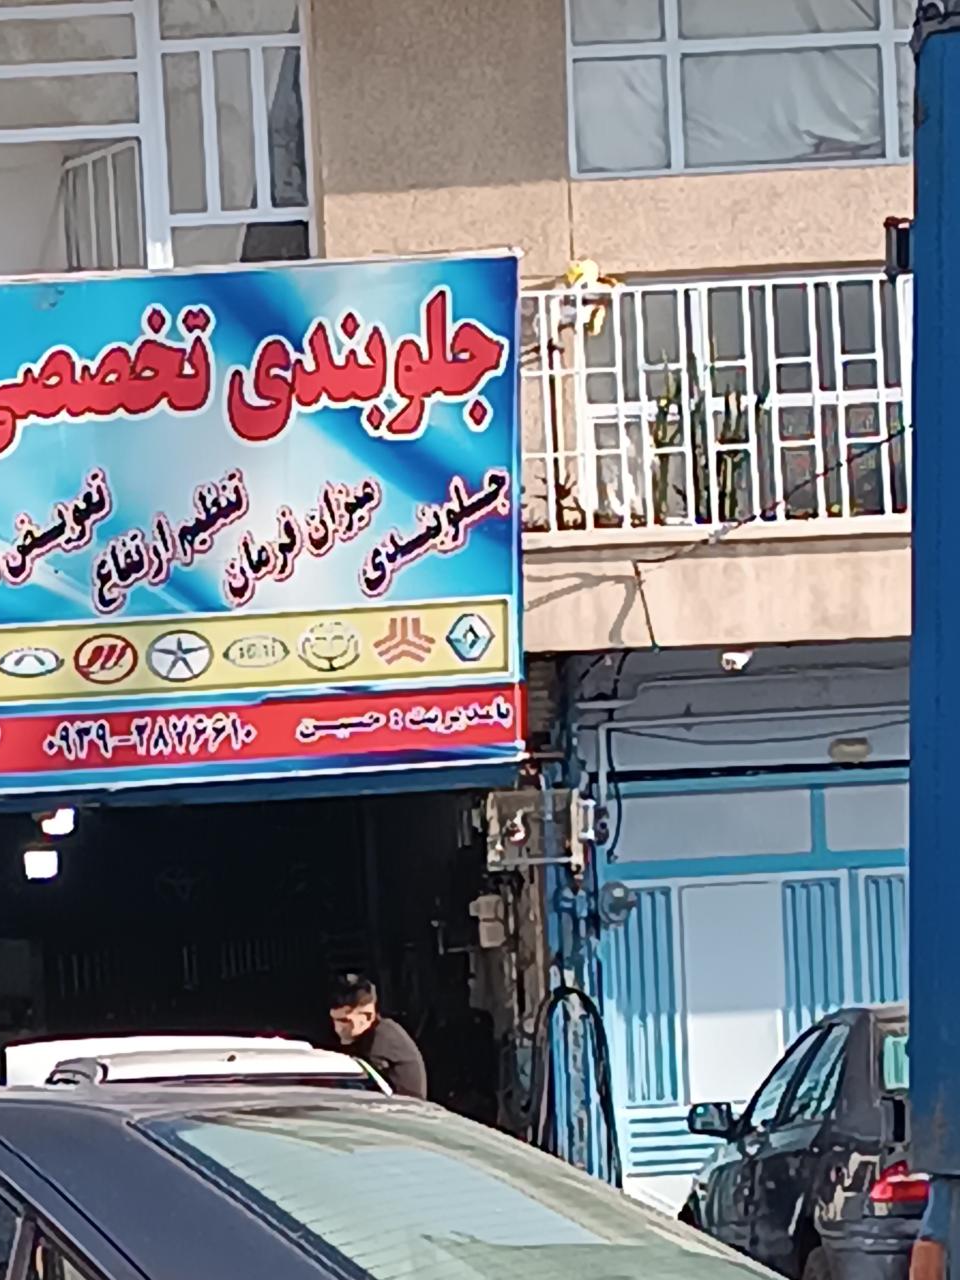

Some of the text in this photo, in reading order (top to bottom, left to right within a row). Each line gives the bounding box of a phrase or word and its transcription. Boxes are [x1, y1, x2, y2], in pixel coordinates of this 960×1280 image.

[224, 287, 507, 443] جلوبندی
[4, 470, 110, 583] تعویض
[92, 469, 248, 612] تنظیم ارتفاع
[224, 479, 381, 605] میزان فرمان
[359, 468, 509, 596] جلوبندی
